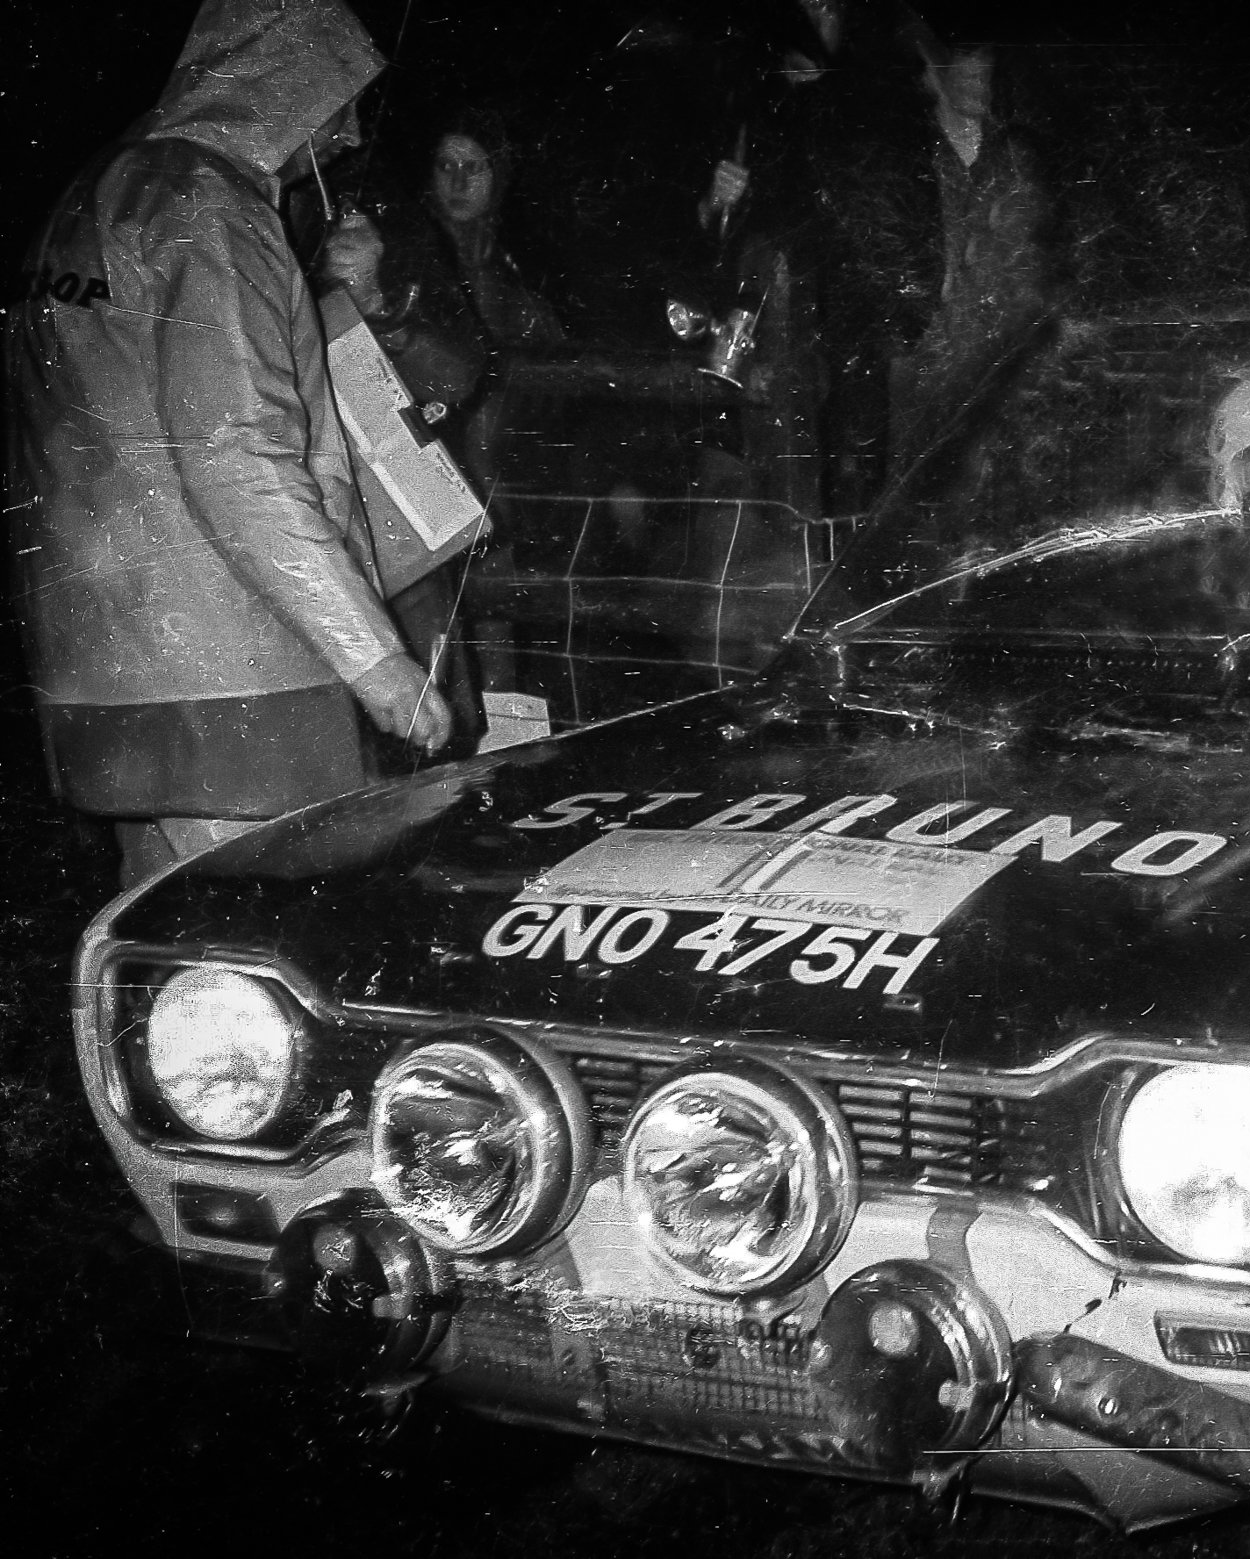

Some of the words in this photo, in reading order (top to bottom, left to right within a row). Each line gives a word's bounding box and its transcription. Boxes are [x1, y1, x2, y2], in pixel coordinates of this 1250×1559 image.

[688, 793, 1227, 876] BRUNO
[482, 903, 670, 965] GNO
[673, 914, 940, 995] 475H
[797, 899, 910, 924] MIRROR
